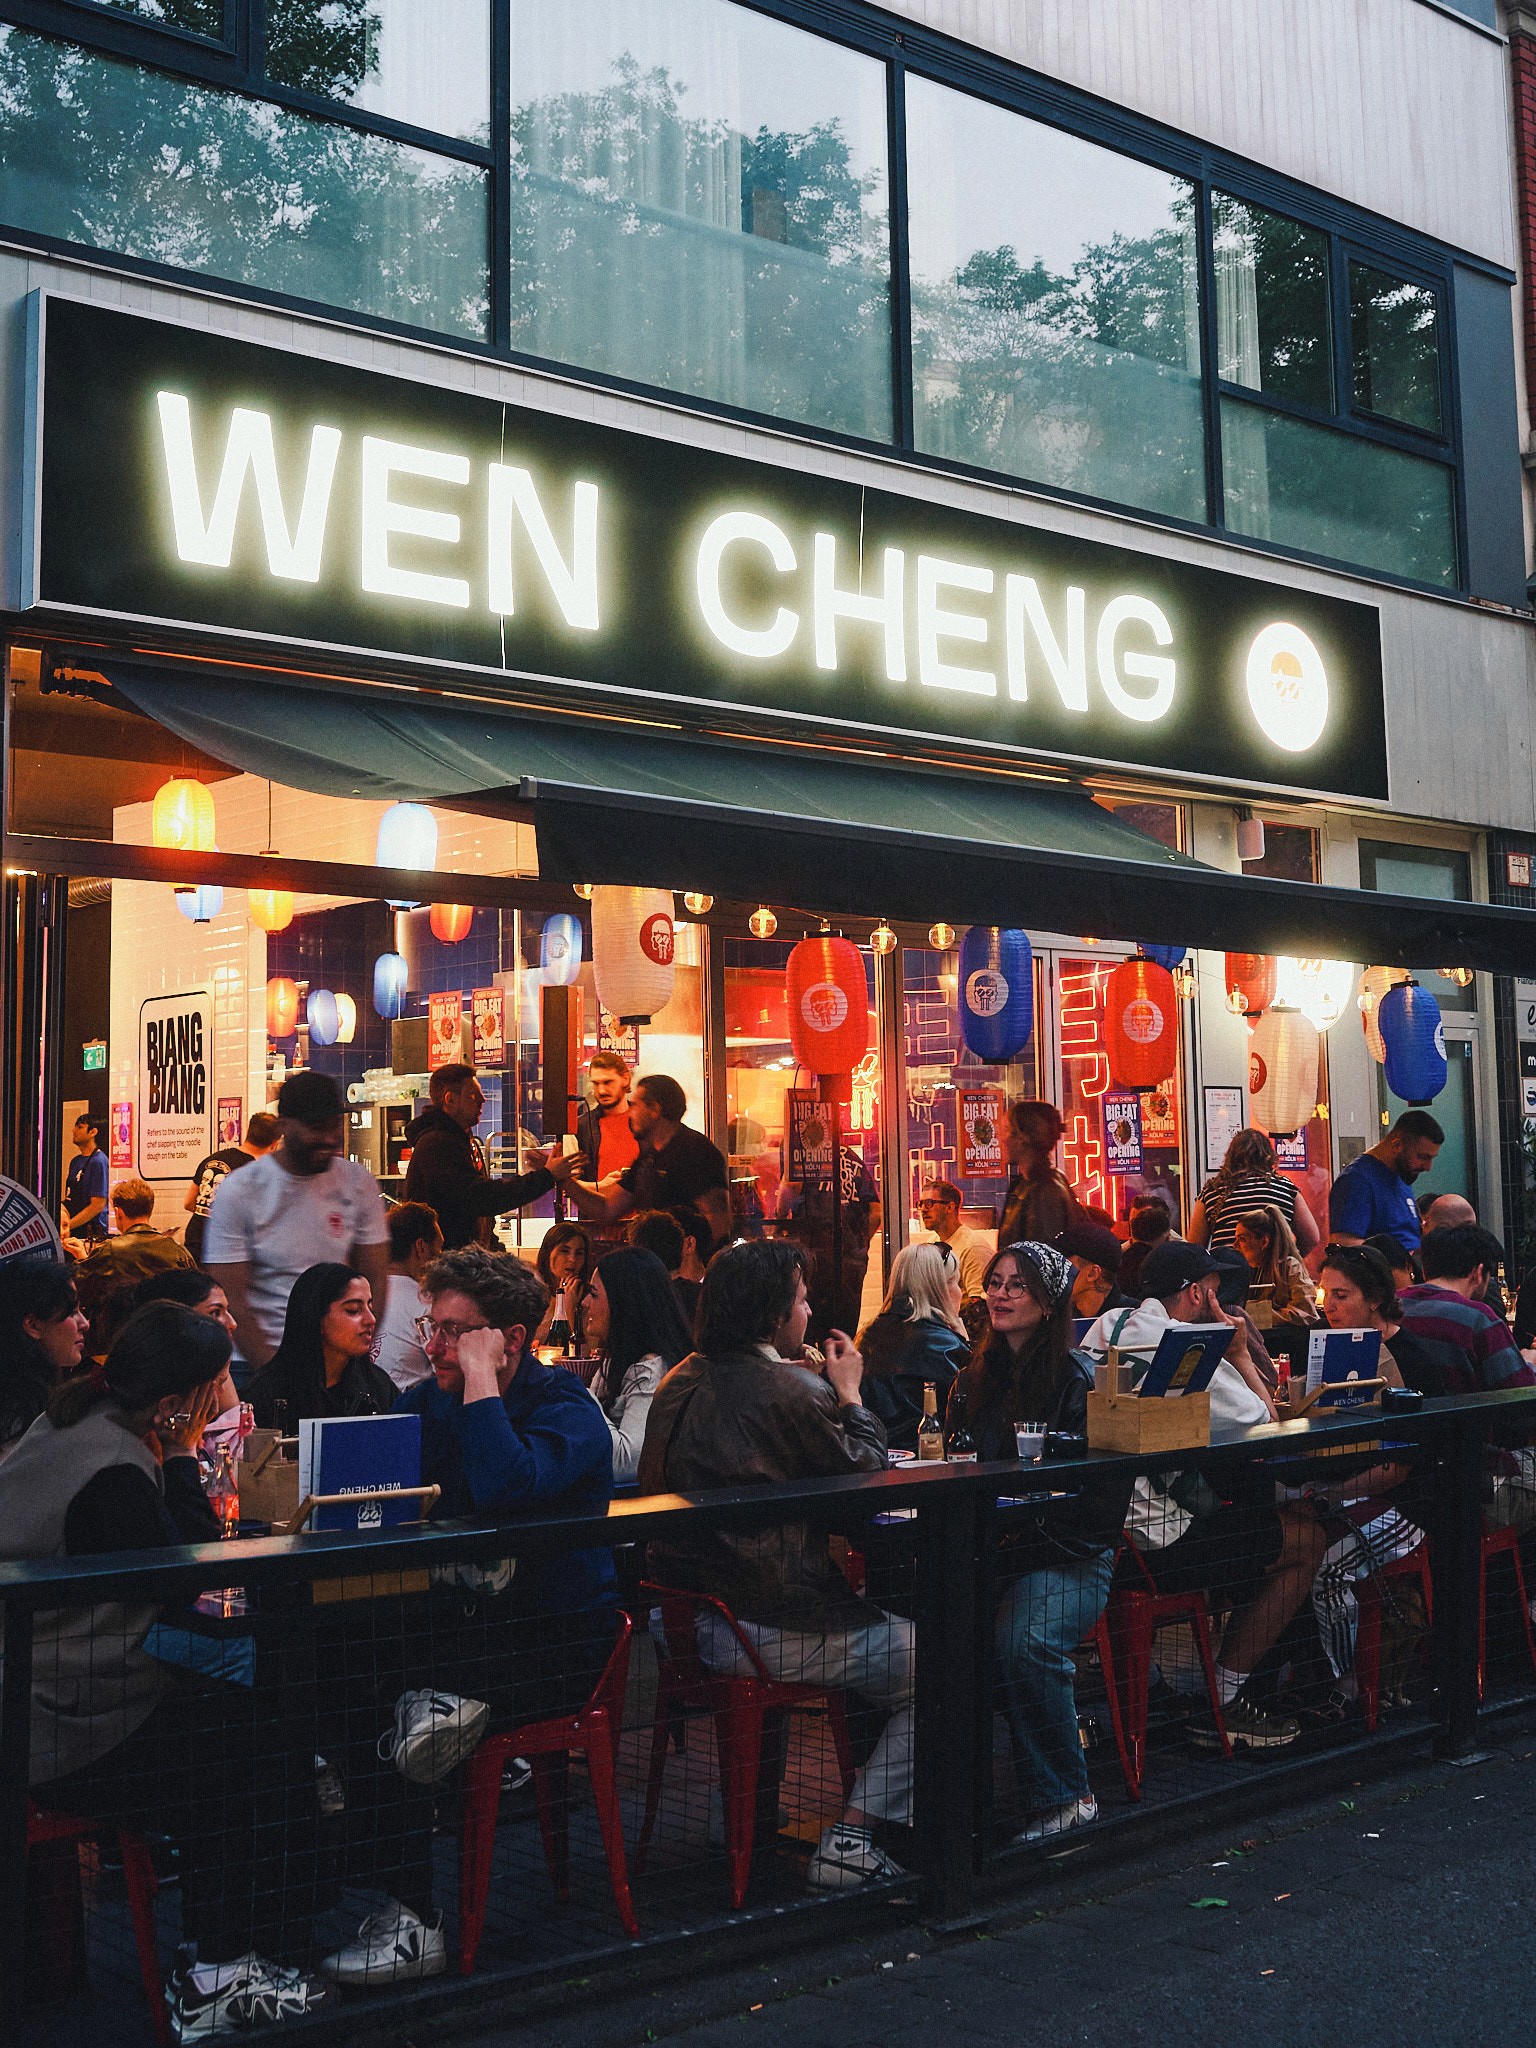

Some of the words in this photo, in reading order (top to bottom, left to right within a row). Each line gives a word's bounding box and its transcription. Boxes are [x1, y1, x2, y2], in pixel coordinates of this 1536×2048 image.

[156, 390, 601, 634] WEN
[695, 510, 1178, 723] CHENG
[147, 1012, 203, 1071] BIANG
[149, 1064, 206, 1115] BIANG
[963, 1103, 979, 1121] BIG
[1105, 1105, 1121, 1121] BIG
[147, 1128, 161, 1137] Refers
[176, 1127, 190, 1135] sound
[147, 1140, 157, 1148] chef
[158, 1140, 176, 1149] slapping
[185, 1138, 201, 1147] noodle
[147, 1152, 160, 1161] dough
[176, 1151, 188, 1159] table
[965, 1147, 1001, 1161] OPENING
[1107, 1145, 1141, 1159] OPENING
[22, 1220, 47, 1245] BAO
[1333, 1398, 1346, 1406] WEN
[1346, 1396, 1365, 1404] CHENG
[339, 1484, 376, 1496] CHENG
[379, 1482, 402, 1493] WEN
